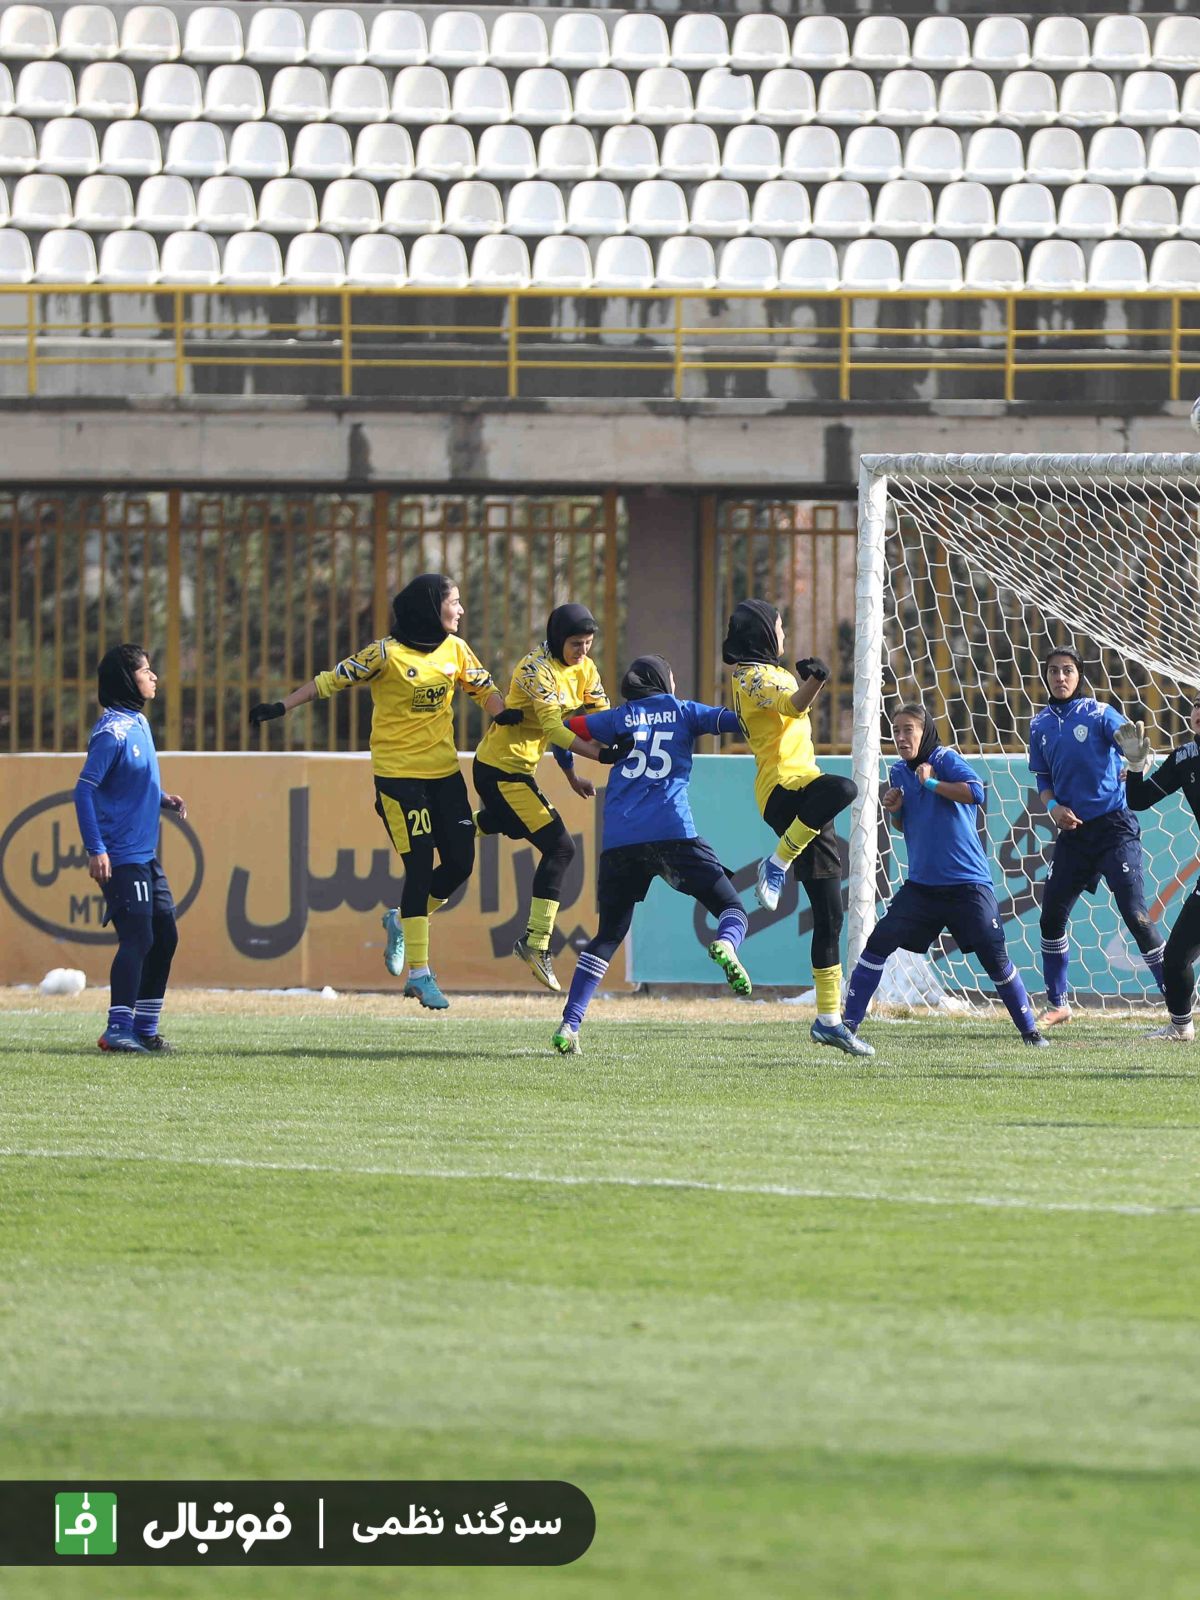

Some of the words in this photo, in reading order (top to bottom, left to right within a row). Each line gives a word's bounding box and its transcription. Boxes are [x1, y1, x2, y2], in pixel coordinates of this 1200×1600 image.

[620, 731, 674, 779] 55
[407, 808, 432, 837] 20
[134, 881, 149, 902] 11
[69, 895, 106, 925] MT
